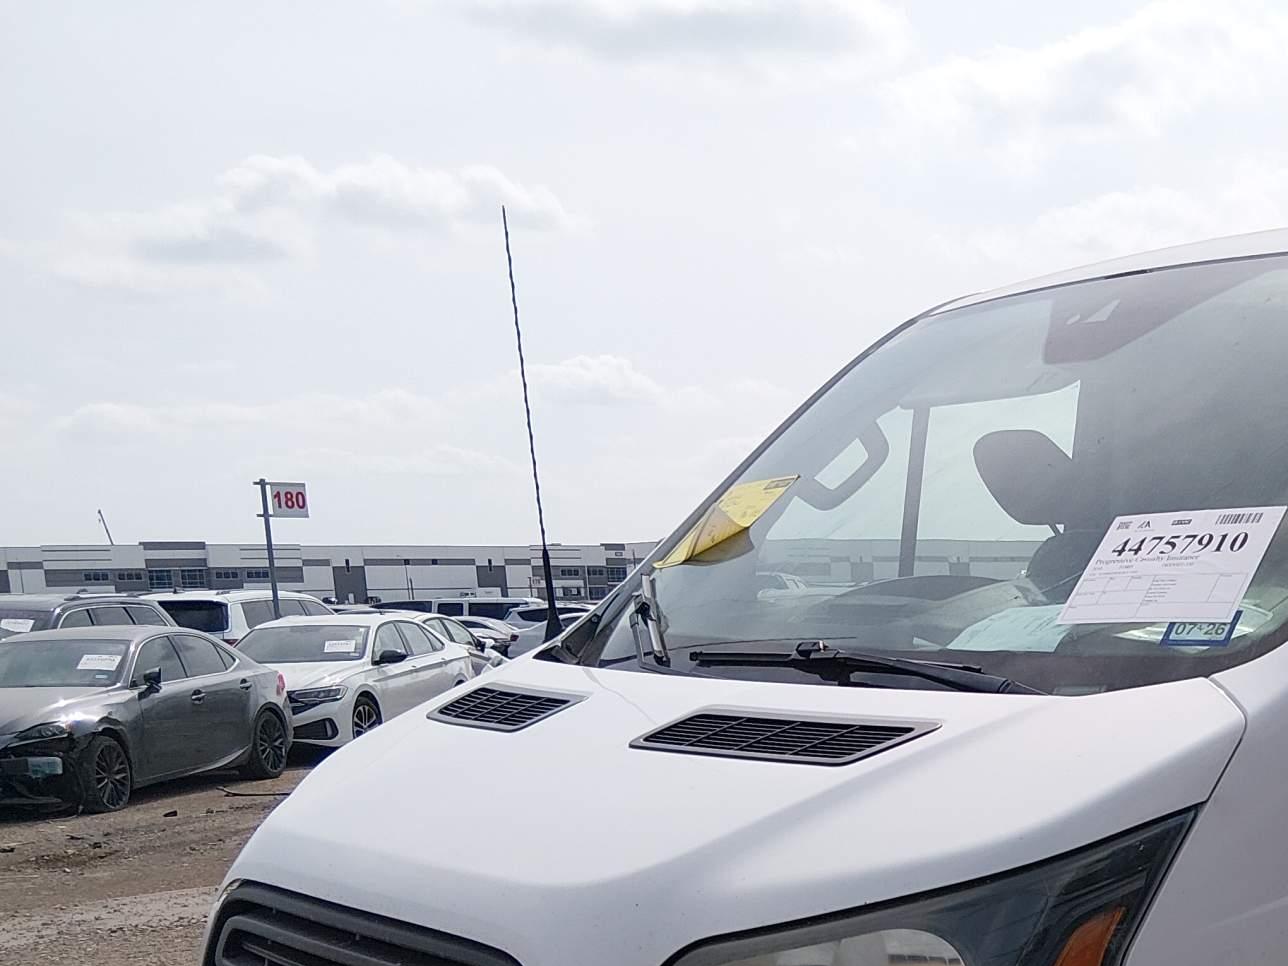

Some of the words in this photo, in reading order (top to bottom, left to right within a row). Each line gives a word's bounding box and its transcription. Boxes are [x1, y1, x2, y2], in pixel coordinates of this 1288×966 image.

[273, 490, 306, 510] 180
[1111, 531, 1249, 557] 44757910
[1203, 622, 1227, 636] 26
